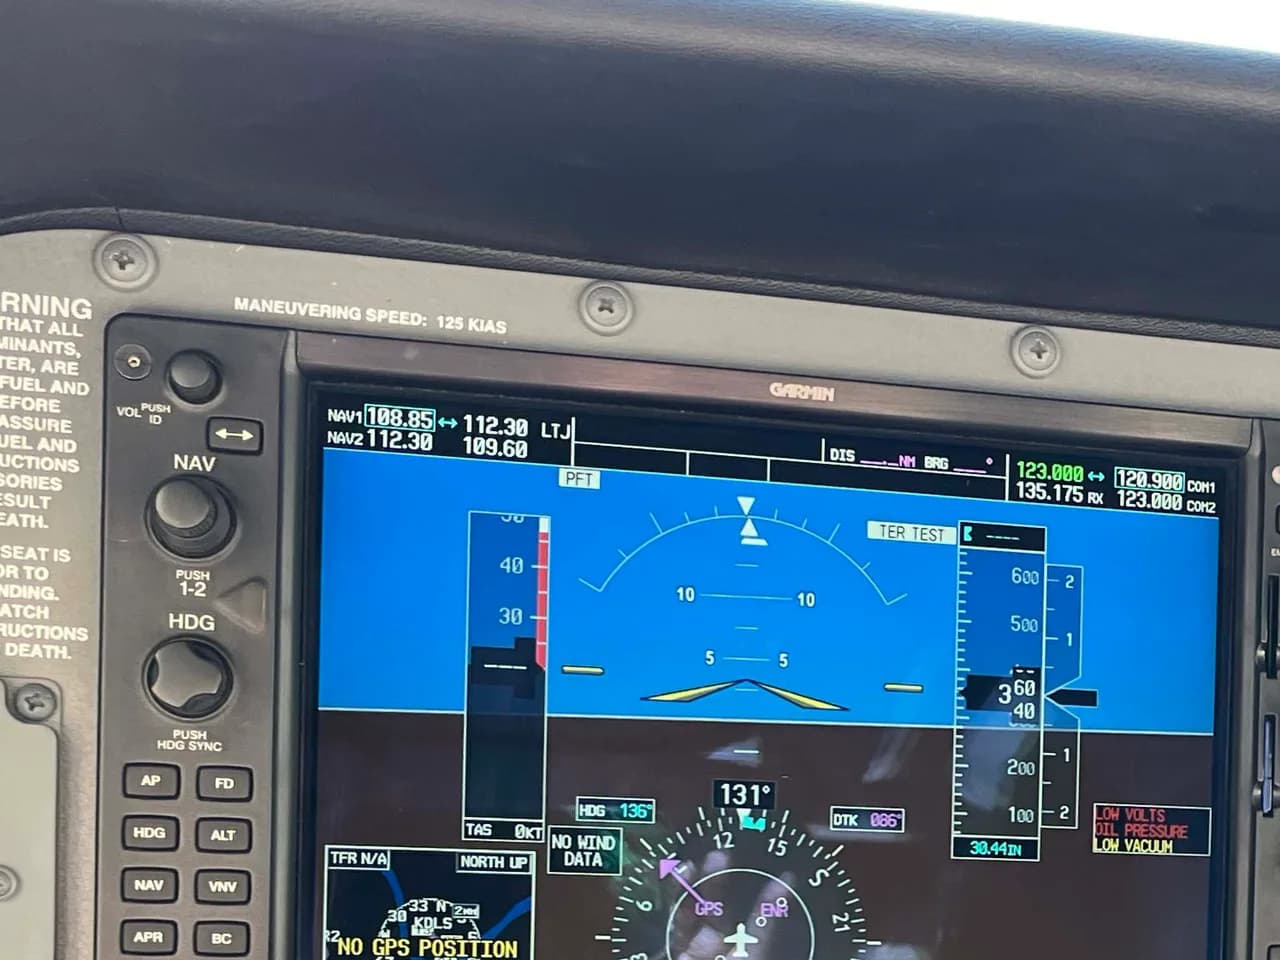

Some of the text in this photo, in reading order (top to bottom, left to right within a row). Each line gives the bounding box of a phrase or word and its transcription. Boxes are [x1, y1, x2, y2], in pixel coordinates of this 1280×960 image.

[234, 297, 507, 334] MANEUVERING SPEED: 125 KIAS
[48, 321, 83, 337] ALL
[41, 359, 79, 376] ARE
[1, 375, 90, 396] FUEL AND
[769, 382, 835, 402] GARMIN
[328, 407, 571, 439] NAV1 108.85 112.30 LTJ
[327, 429, 528, 458] NAV2 112.30 109.60
[173, 454, 216, 472] NAV
[566, 471, 592, 486] PFT
[1017, 461, 1215, 493] 123.000 120.900 COM1
[1017, 481, 1216, 514] 135.175 RX 123.000 COM2
[880, 524, 944, 542] TER TEST
[1, 545, 71, 562] SEAT IS
[1012, 567, 1040, 585] 600
[168, 613, 215, 631] HDG
[1011, 615, 1038, 633] 500
[5, 643, 72, 659] DEATH.
[157, 741, 222, 752] HDG SYNC
[141, 775, 161, 786] AP
[720, 783, 770, 806] 131°
[580, 804, 653, 818] HDG 136°
[1096, 806, 1166, 823] LOW VOLTS
[134, 827, 166, 838] HDG
[211, 830, 236, 841] ALT
[1096, 824, 1188, 839] OIL PRESSURE
[552, 835, 615, 851] NO WIND
[970, 840, 1021, 857] 30.44IN
[1095, 838, 1173, 854] LOW VACUUM
[461, 855, 528, 869] NORTH UP
[564, 851, 603, 868] DATA
[135, 880, 164, 890] NAV
[133, 932, 163, 943] APR
[337, 938, 518, 959] NO GPS POSITION
